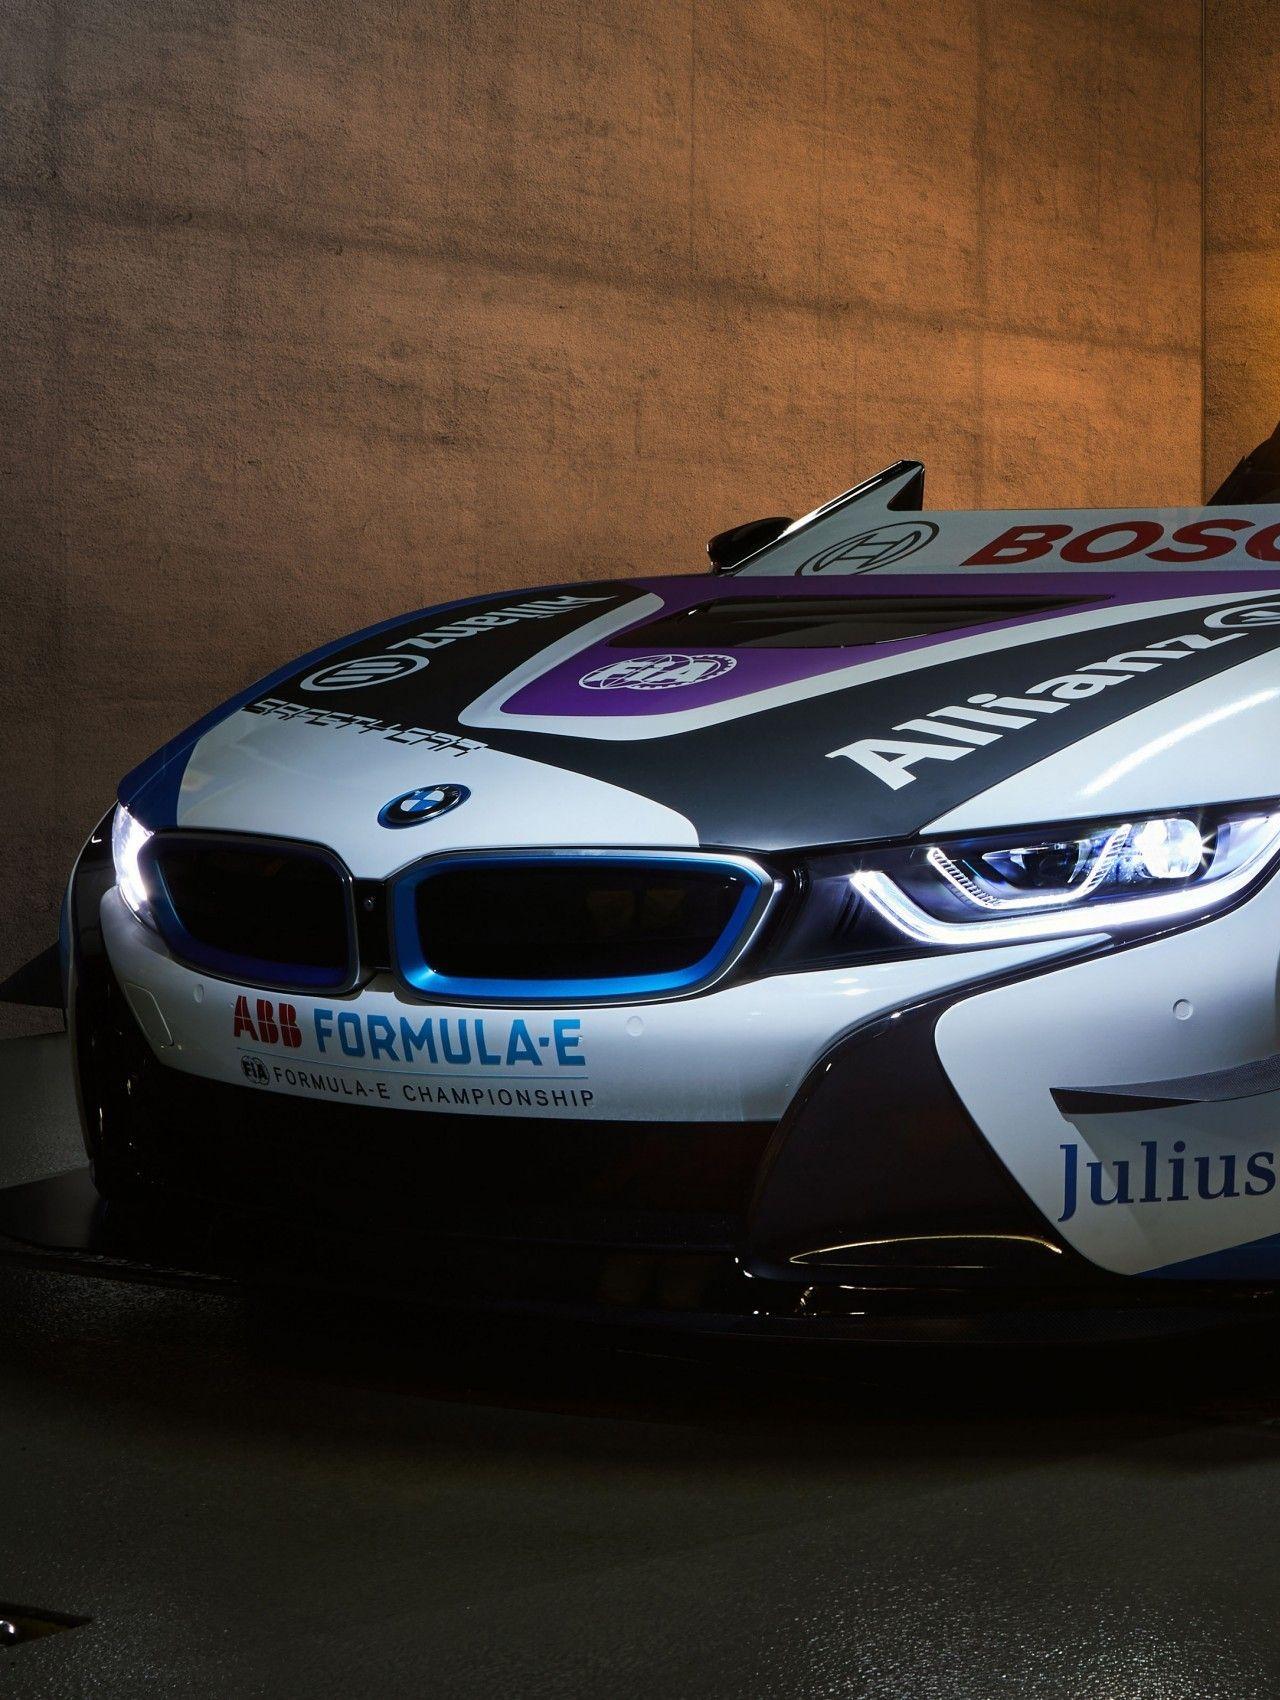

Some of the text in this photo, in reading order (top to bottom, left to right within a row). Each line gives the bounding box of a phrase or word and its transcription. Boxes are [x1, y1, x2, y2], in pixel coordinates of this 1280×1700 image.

[386, 595, 617, 650] Allianz
[242, 698, 488, 757] SAFETY CAR
[825, 632, 1249, 791] Allianz
[233, 995, 303, 1048] ABB
[273, 1066, 391, 1100] FORMULA-E
[403, 1085, 594, 1108] CHAMPIONSHIP
[1057, 1140, 1277, 1222] Julius
